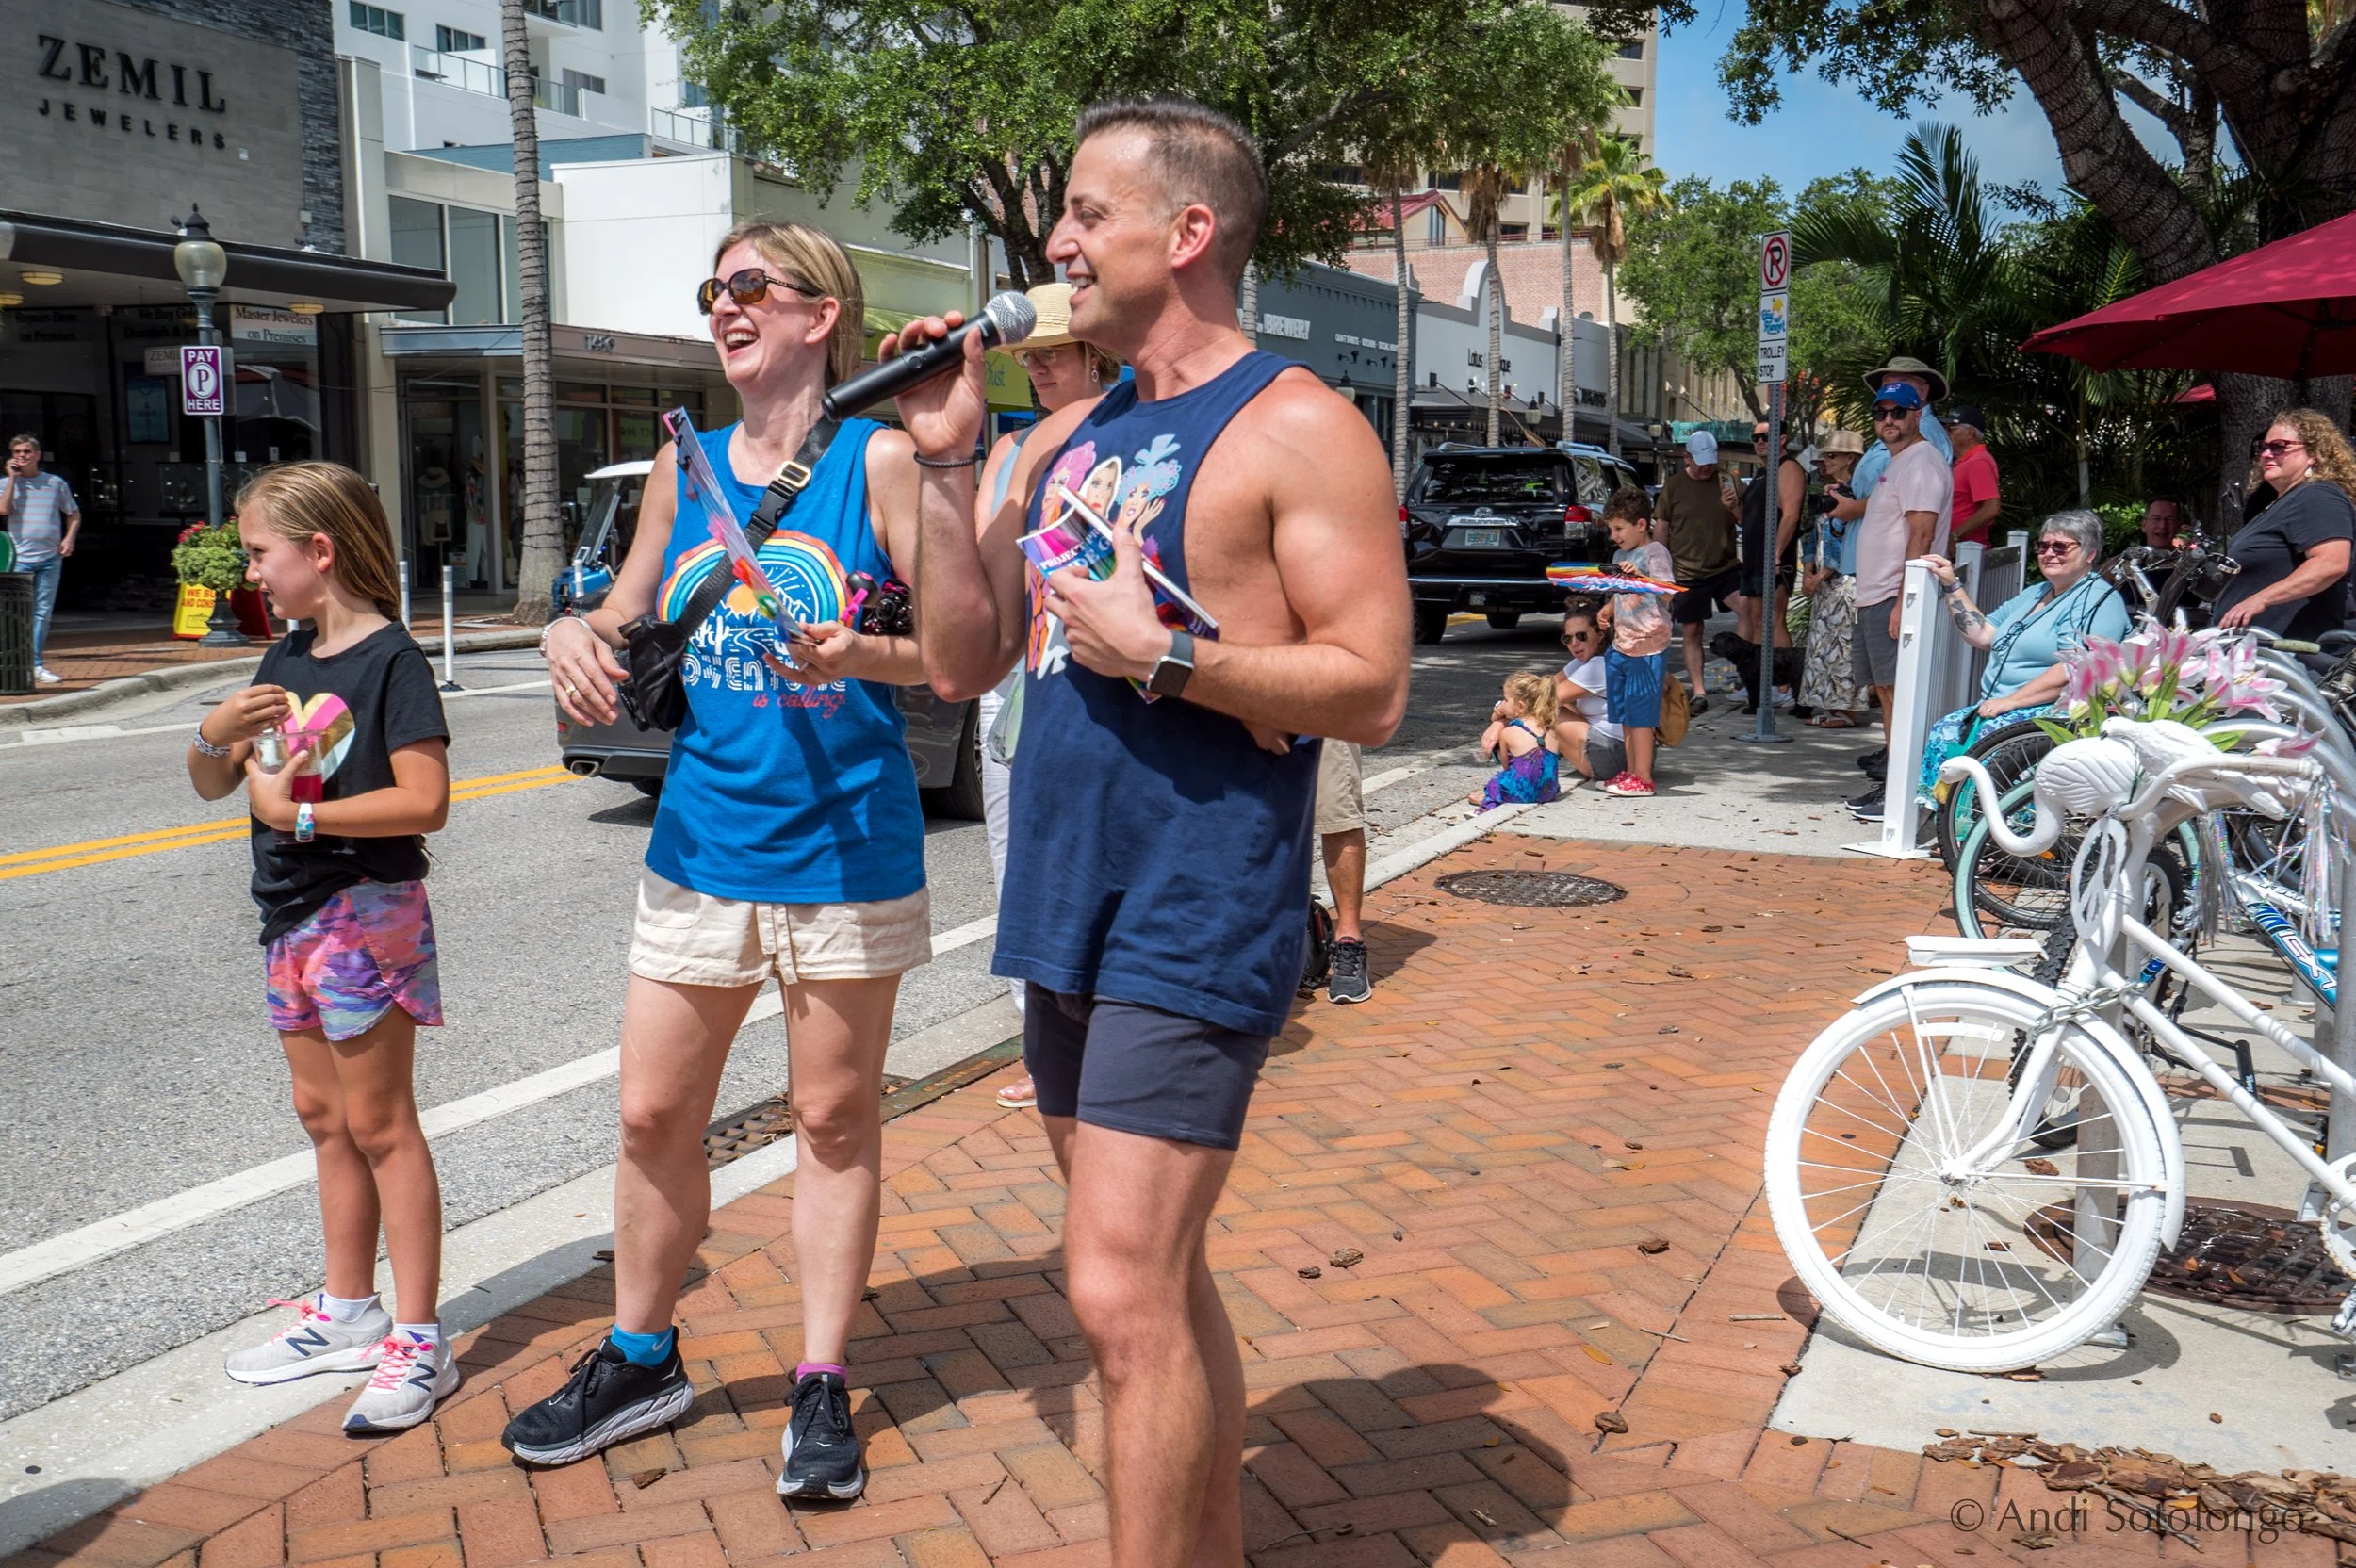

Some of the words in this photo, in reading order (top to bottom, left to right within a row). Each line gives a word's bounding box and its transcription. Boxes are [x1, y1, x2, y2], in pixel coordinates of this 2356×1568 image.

[38, 34, 226, 114] ZEMIL
[39, 99, 225, 150] JEWELERS
[236, 305, 272, 322] Master
[272, 310, 314, 326] Jewelers
[248, 330, 261, 339] on
[263, 330, 307, 343] Premises
[1263, 313, 1311, 340] BREWERY
[188, 351, 214, 362] PAY
[1468, 348, 1483, 368] Lotus
[1760, 346, 1786, 359] TROLLEY
[196, 369, 209, 392] P
[1759, 365, 1775, 378] STOP
[188, 399, 221, 411] HERE
[1039, 542, 1086, 569] PROJECT
[188, 588, 201, 597] WE
[204, 588, 216, 597] BU
[181, 598, 195, 608] AND
[196, 598, 216, 608] CONS
[752, 693, 769, 709] is
[777, 686, 846, 719] calling
